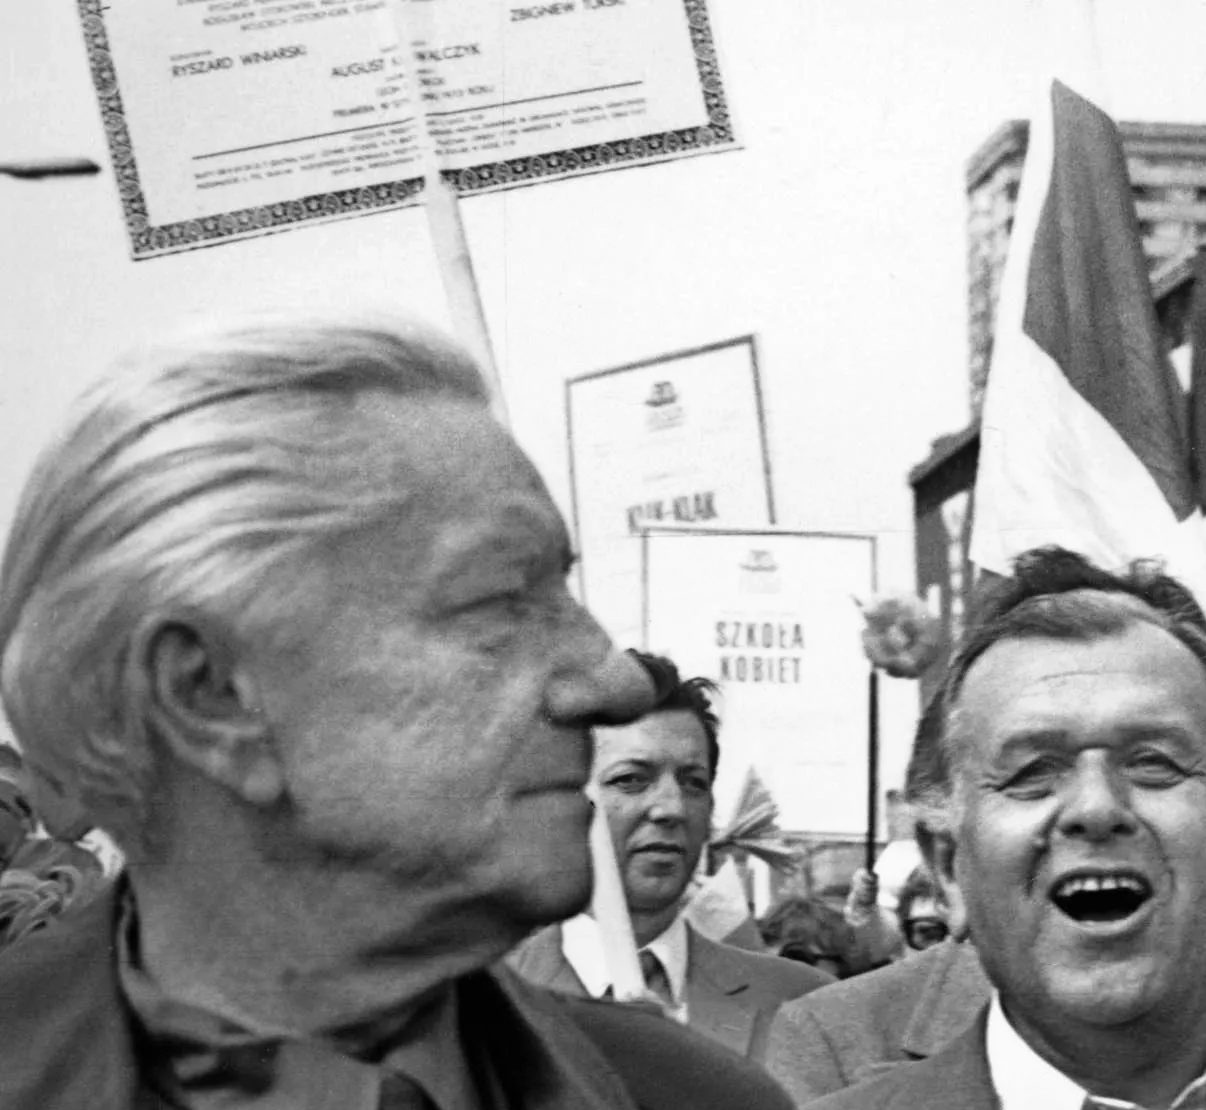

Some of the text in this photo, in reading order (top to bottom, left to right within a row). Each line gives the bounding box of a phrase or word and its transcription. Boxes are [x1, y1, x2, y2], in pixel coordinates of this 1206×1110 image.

[172, 44, 307, 77] RYSZARD WINIARSKI
[332, 58, 383, 77] AUGUST
[715, 621, 805, 649] SZKOŁA
[719, 654, 801, 683] KOBIET
